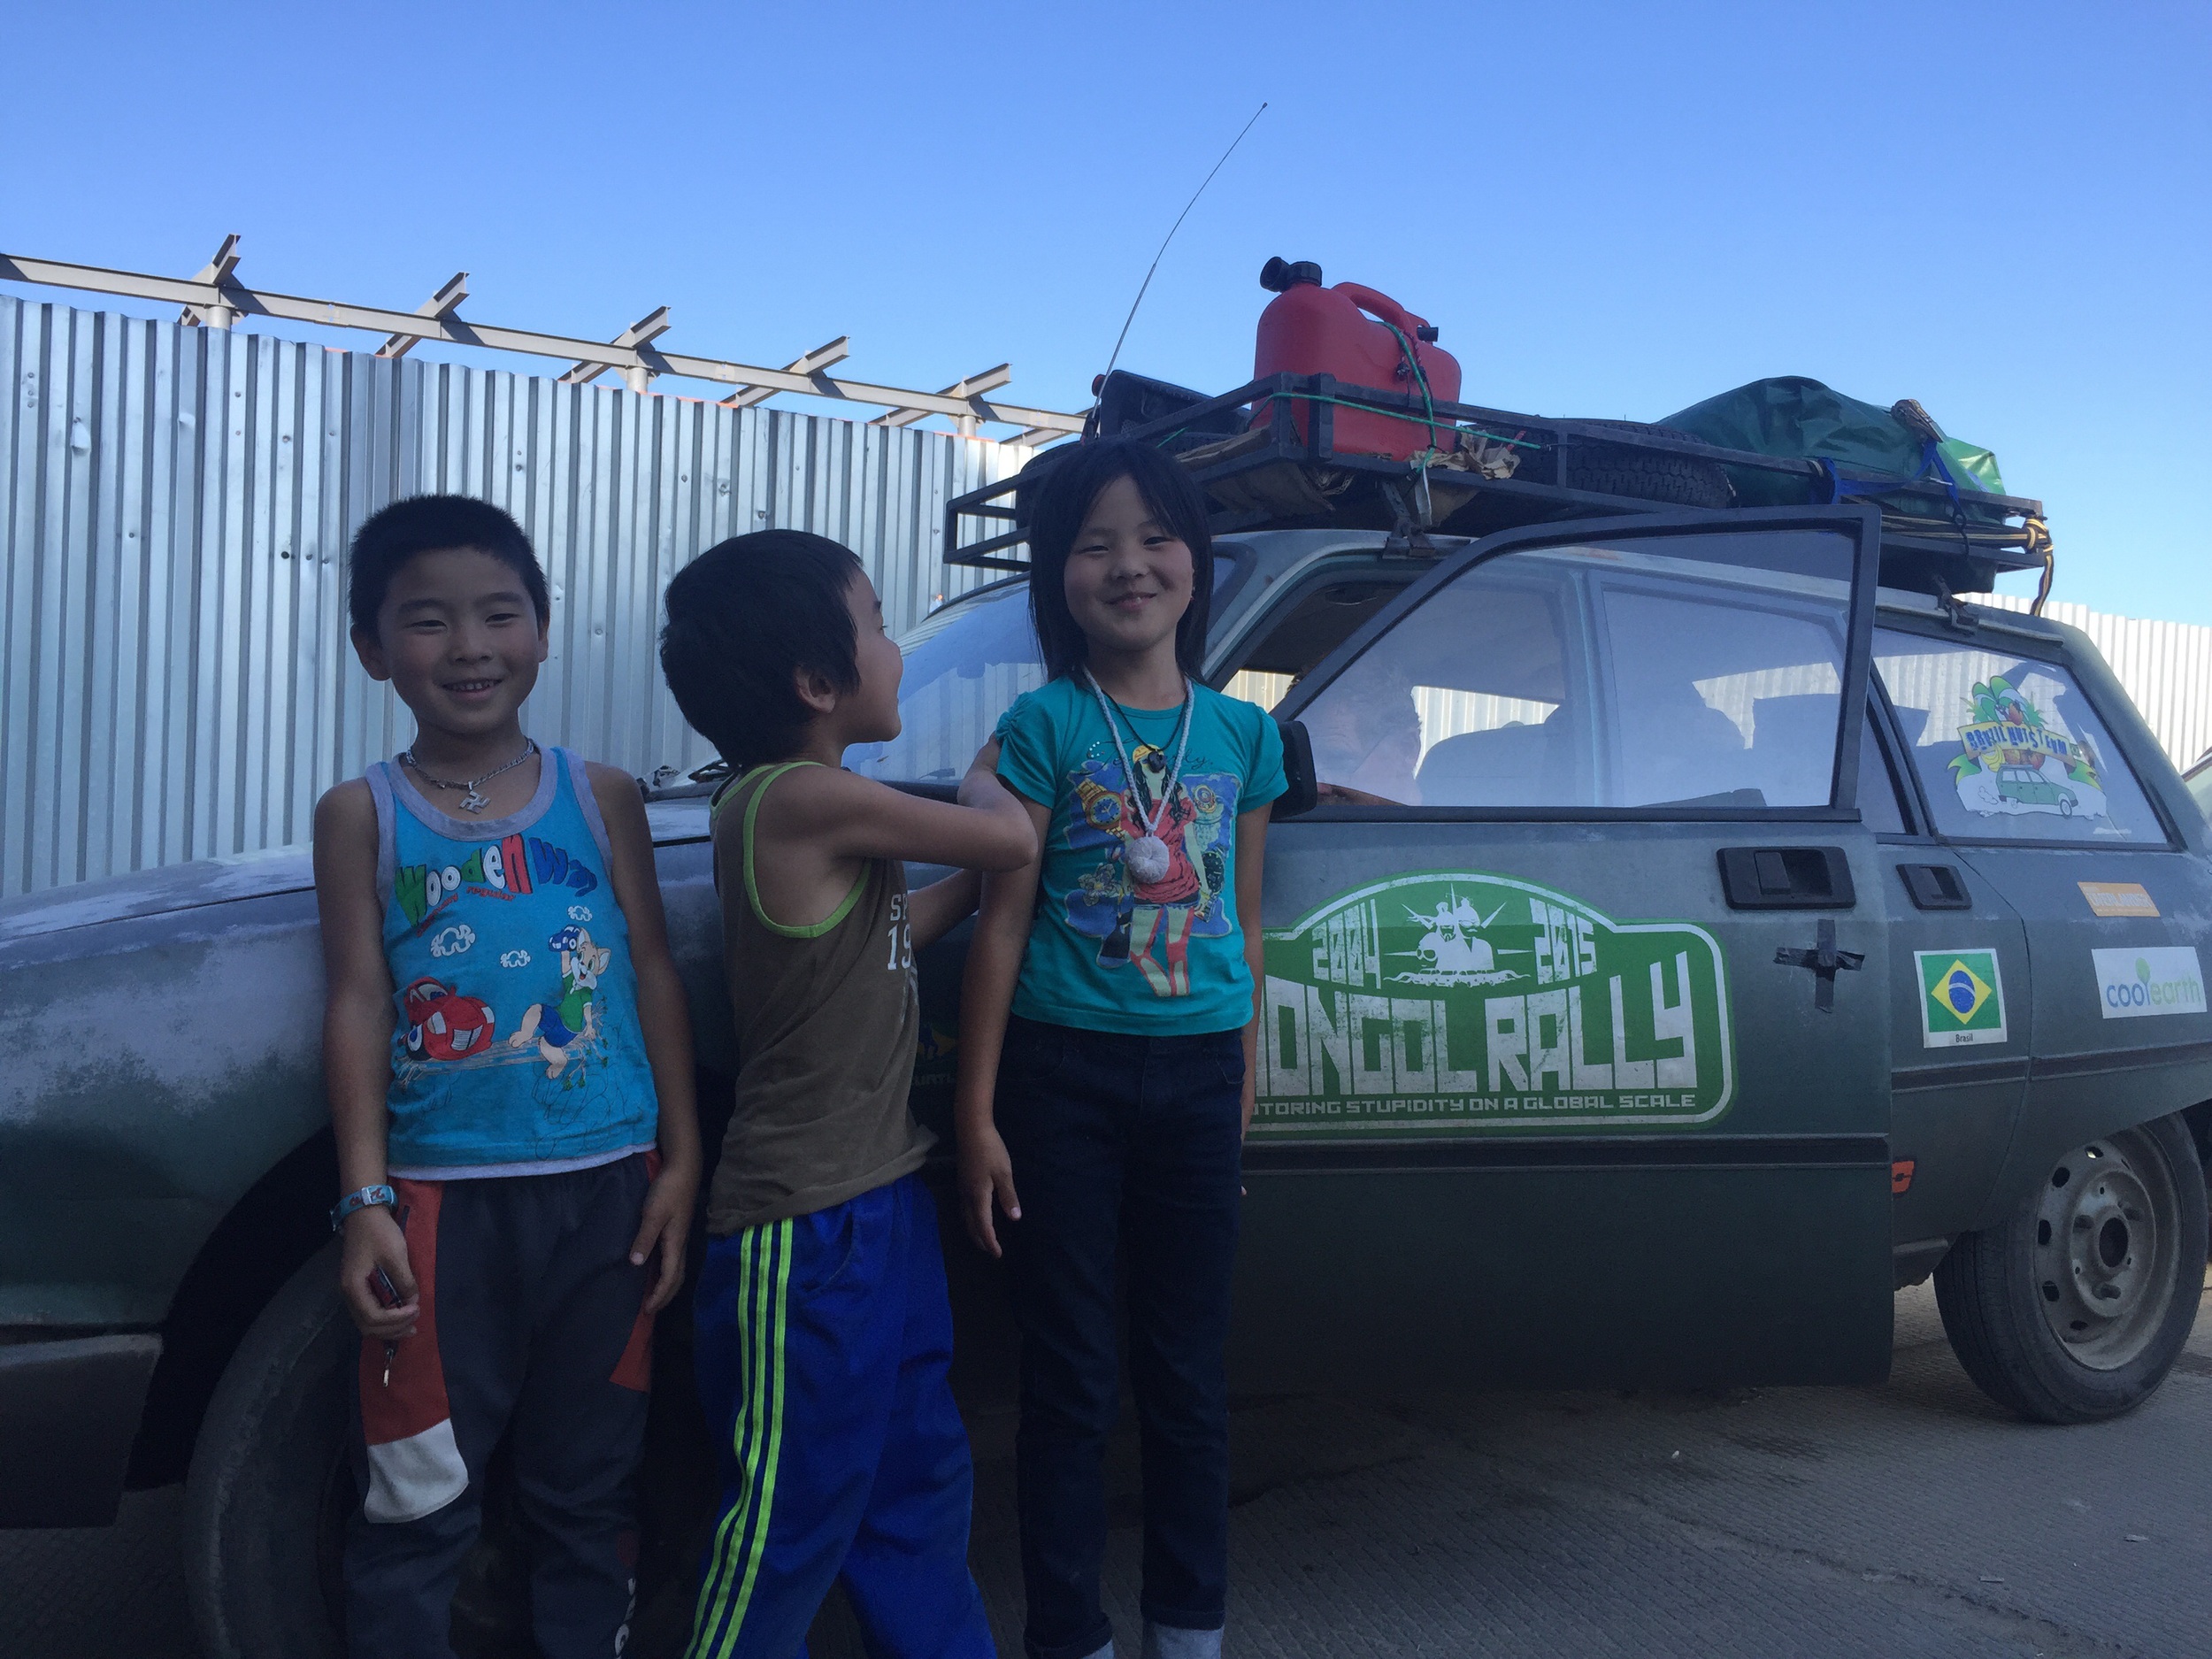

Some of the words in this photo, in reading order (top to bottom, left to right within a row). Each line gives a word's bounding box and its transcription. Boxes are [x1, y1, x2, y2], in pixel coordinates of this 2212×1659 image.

[2007, 726, 2039, 749] NUTS
[529, 837, 598, 897] Way
[1312, 898, 1381, 989] 2004
[1529, 897, 1597, 985] 2015
[1255, 974, 1477, 1097] ONGOL
[1486, 951, 1697, 1092] RALLY
[1955, 1033, 1974, 1043] Brasil
[1248, 1100, 1340, 1116] TORING
[1346, 1098, 1463, 1115] STUPIDITY
[1470, 1097, 1499, 1112] ON
[1505, 1097, 1518, 1110] A
[1523, 1095, 1614, 1111] GLOBAL
[1619, 1094, 1696, 1108] SCALE
